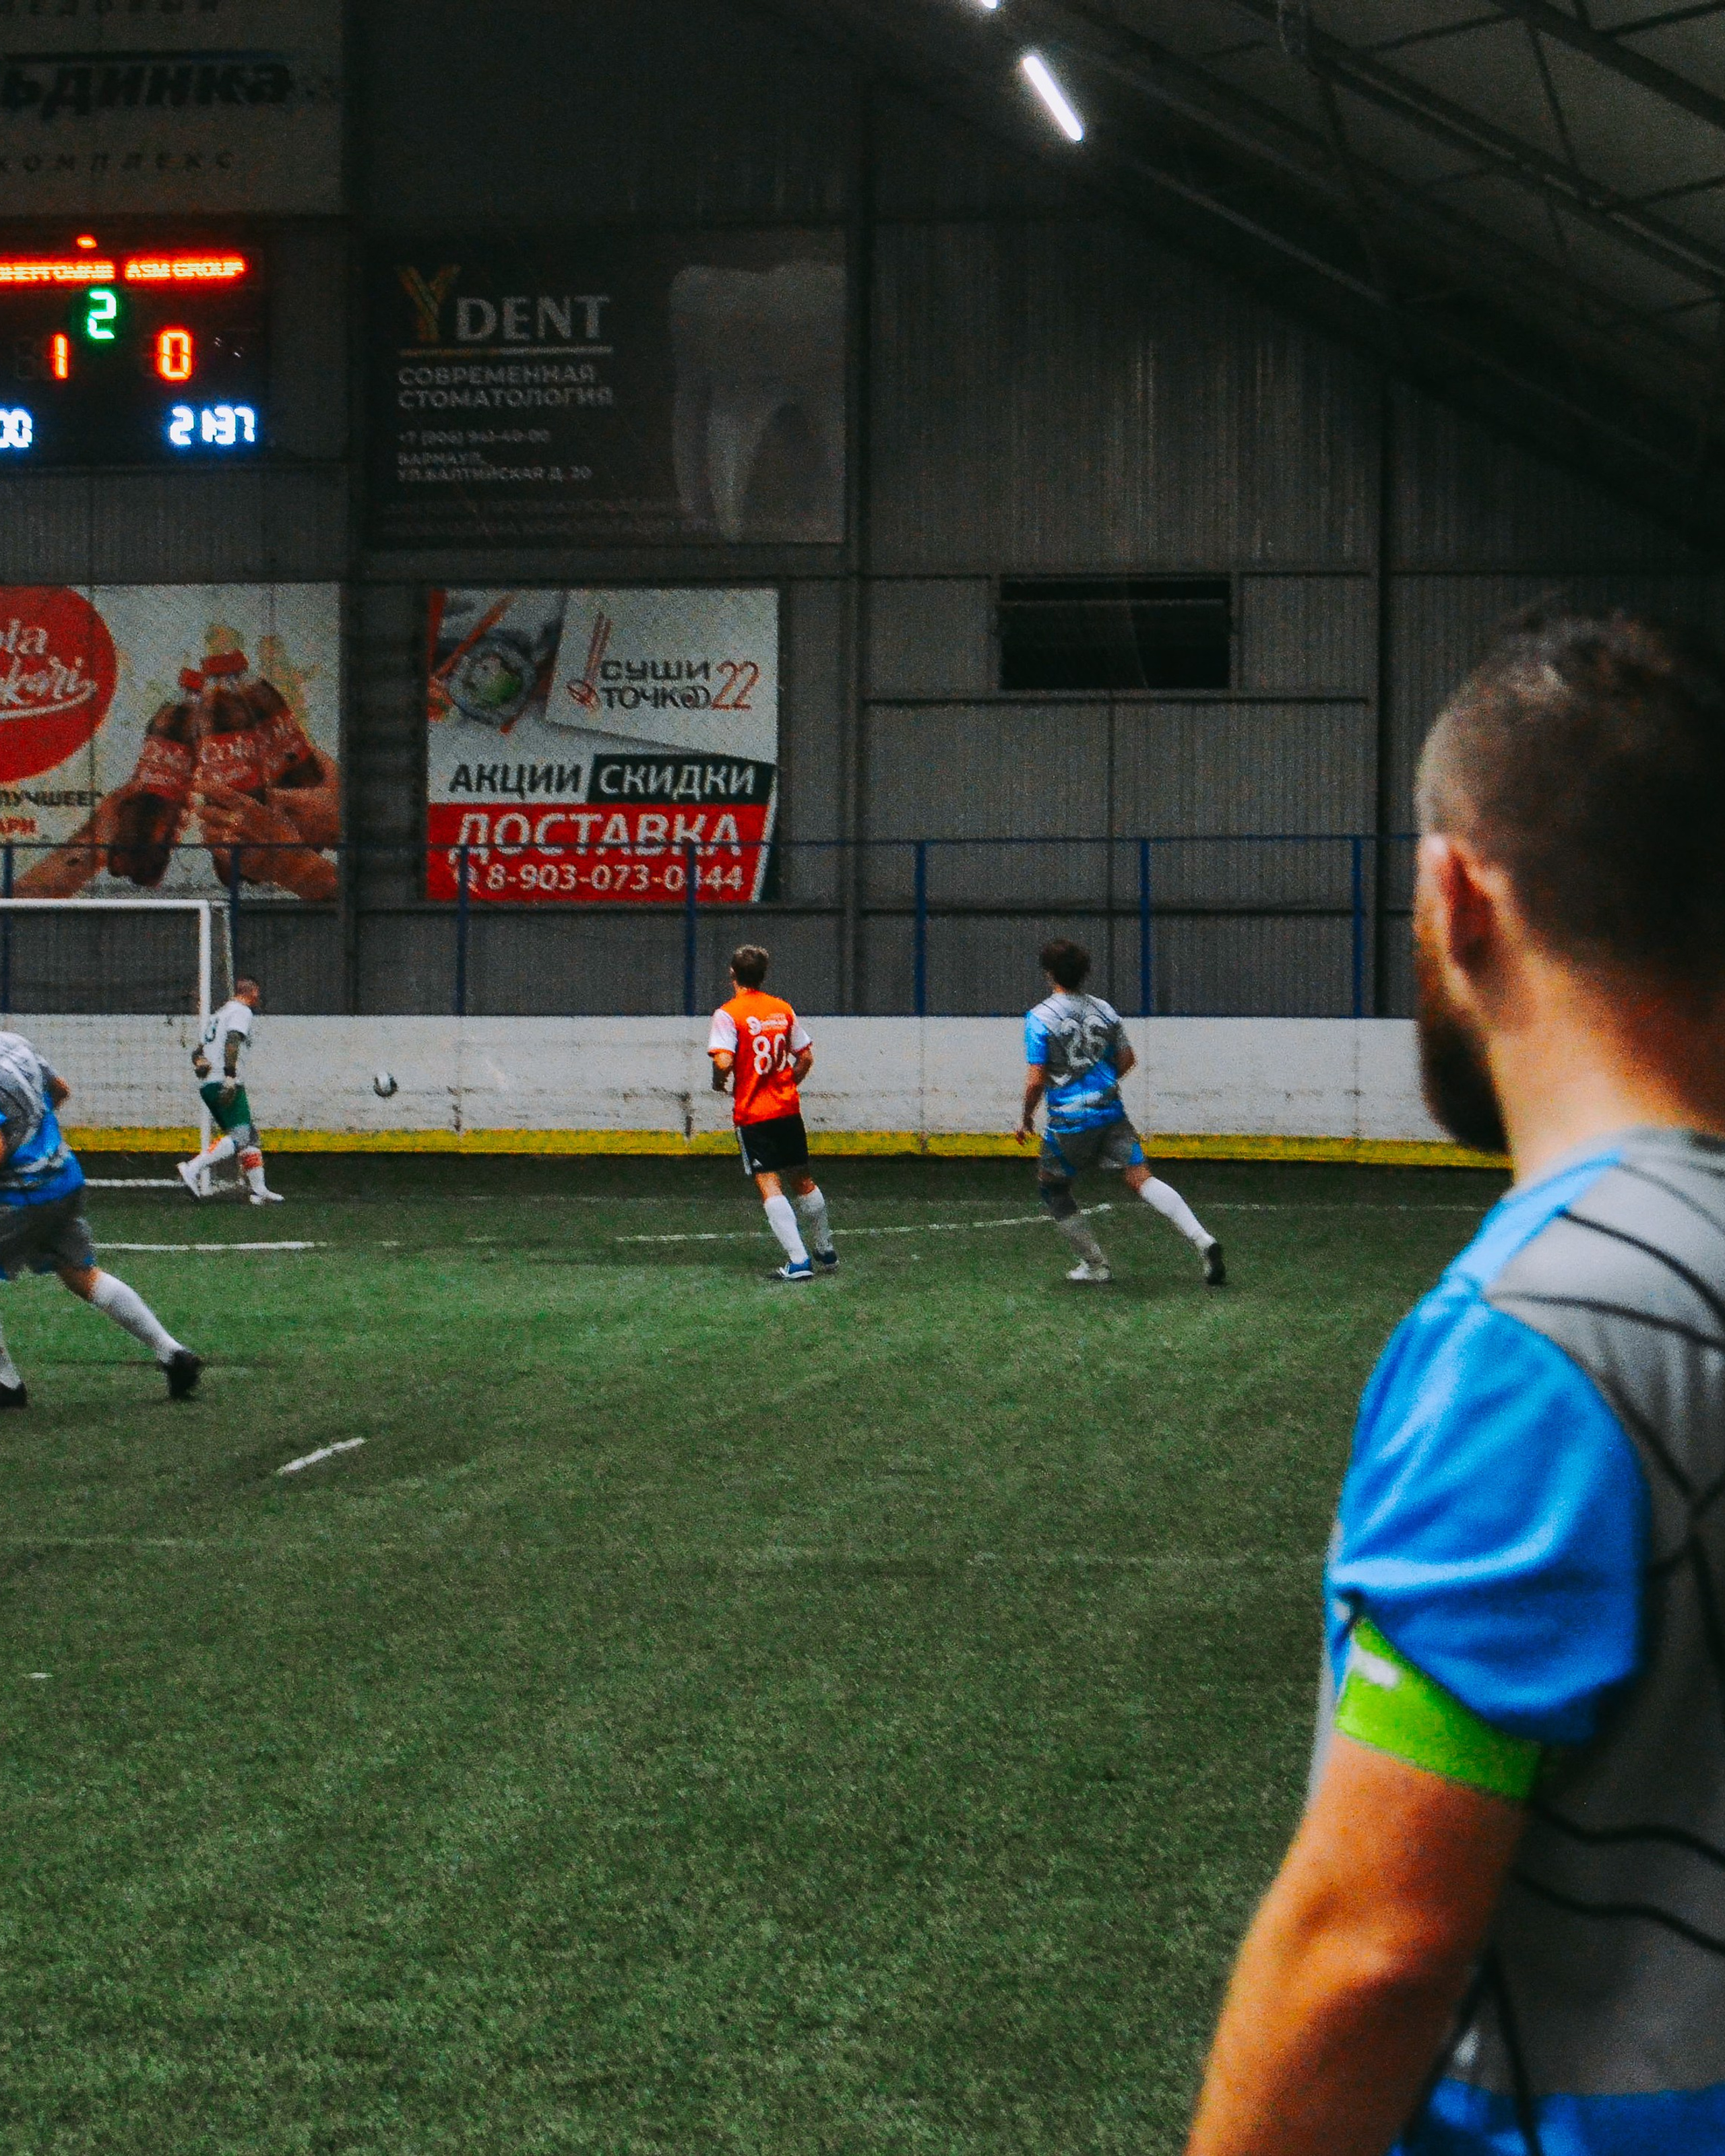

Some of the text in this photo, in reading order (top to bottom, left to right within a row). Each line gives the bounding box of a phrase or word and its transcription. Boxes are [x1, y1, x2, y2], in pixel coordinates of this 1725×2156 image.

[87, 290, 117, 339] 2
[54, 335, 67, 380] 1
[159, 330, 192, 380] 0
[397, 362, 596, 386] СОВРЕМЕННАЯ
[397, 386, 614, 409] СТОМАТОЛОГИЯ
[600, 660, 711, 682] СУШИ
[712, 660, 761, 711] 22
[448, 763, 755, 802] АКЦИИ СКИДКИ
[448, 813, 742, 865] ДОСТАВКА
[751, 1034, 787, 1075] 80
